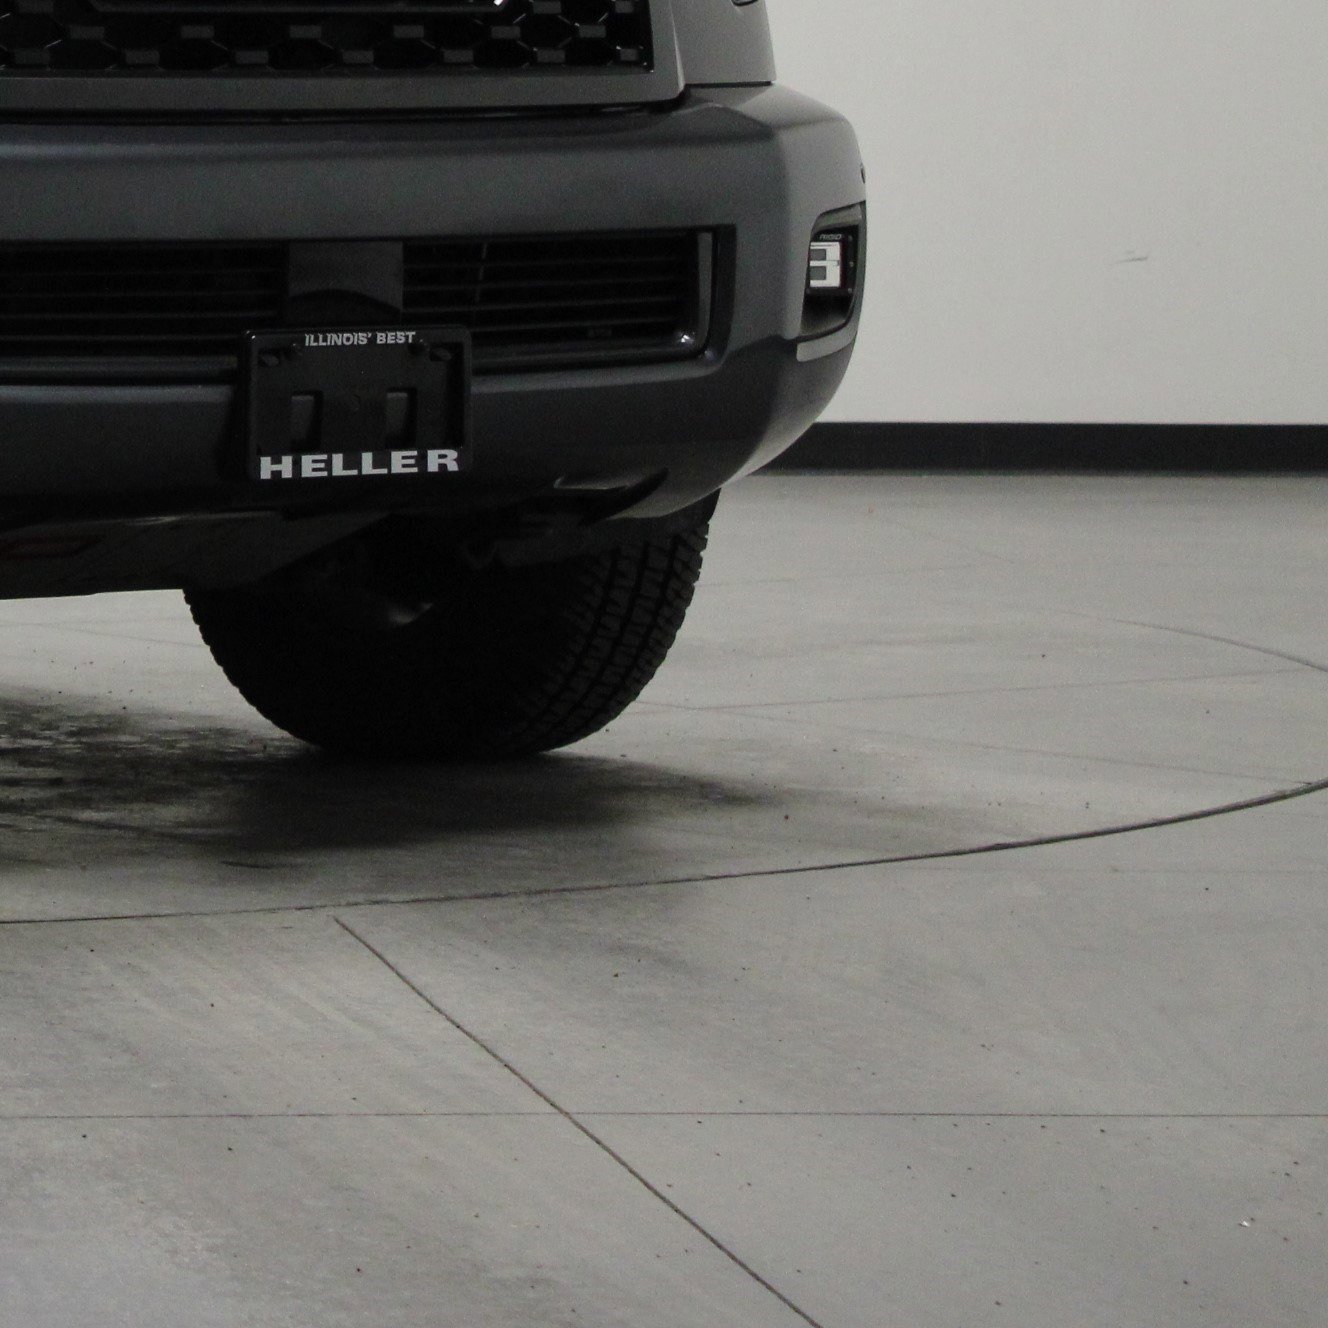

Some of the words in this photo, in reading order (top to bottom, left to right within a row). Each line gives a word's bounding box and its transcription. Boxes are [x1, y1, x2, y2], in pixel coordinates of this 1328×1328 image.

[304, 332, 372, 347] ILLINOIS'
[375, 331, 417, 345] BEST
[259, 449, 460, 480] HELLER
